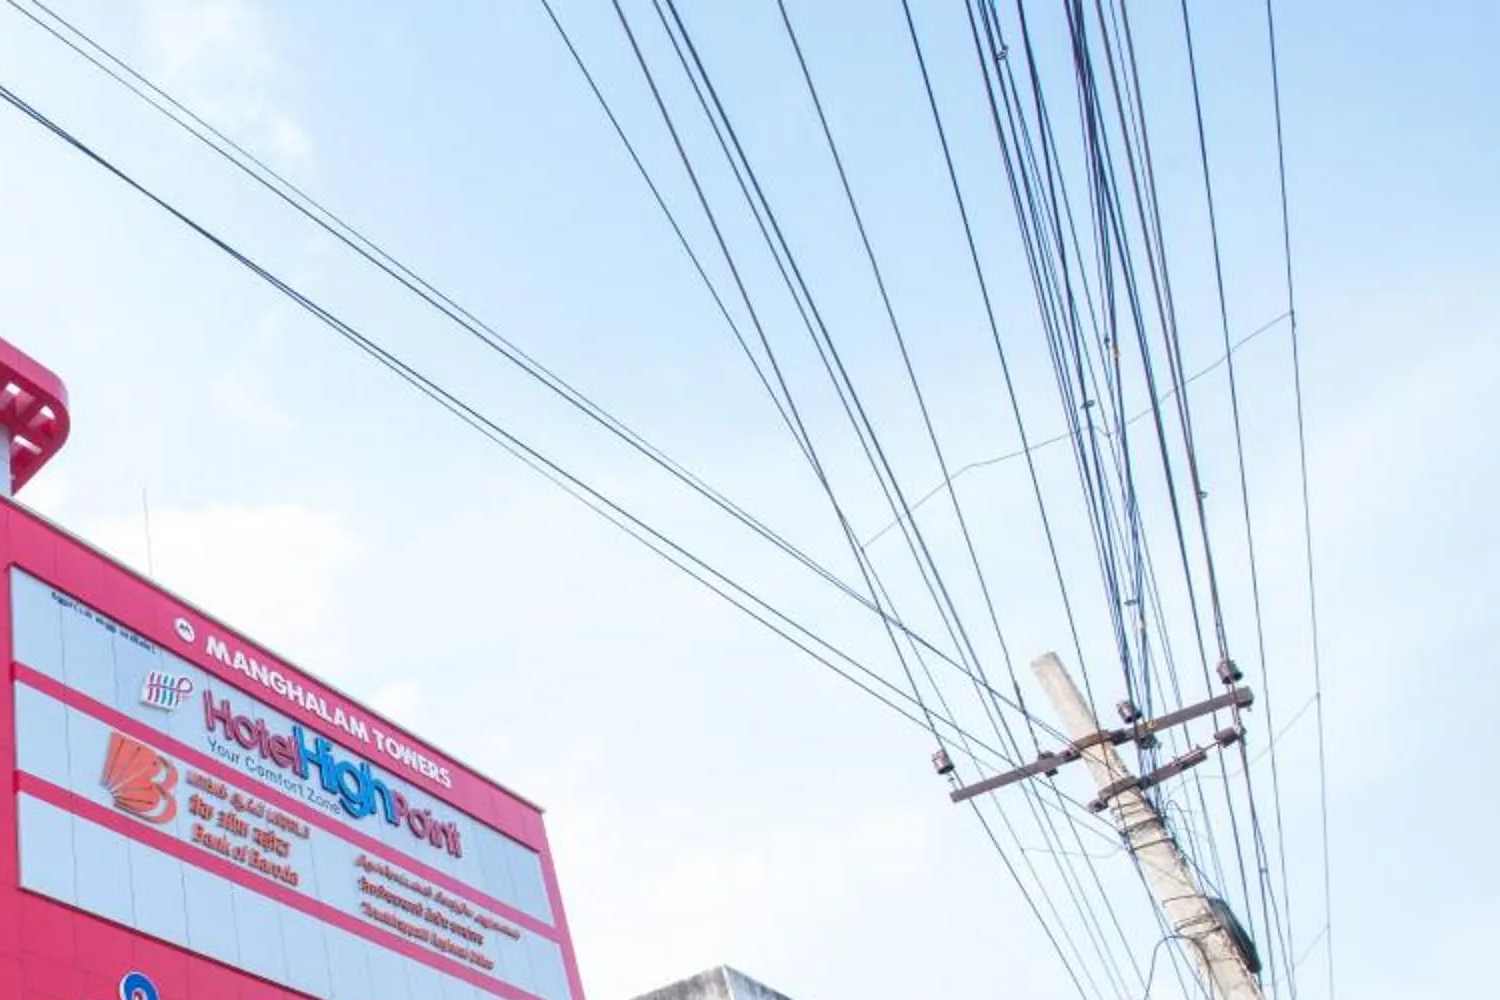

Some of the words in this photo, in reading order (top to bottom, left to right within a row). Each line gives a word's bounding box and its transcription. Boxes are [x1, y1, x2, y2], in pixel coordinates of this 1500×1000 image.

[206, 635, 369, 743] MANGHALAM
[372, 731, 453, 788] TOWERS
[207, 736, 241, 763] Your
[245, 752, 303, 798] Comfort
[306, 785, 341, 815] Zone
[192, 823, 229, 856] Bank
